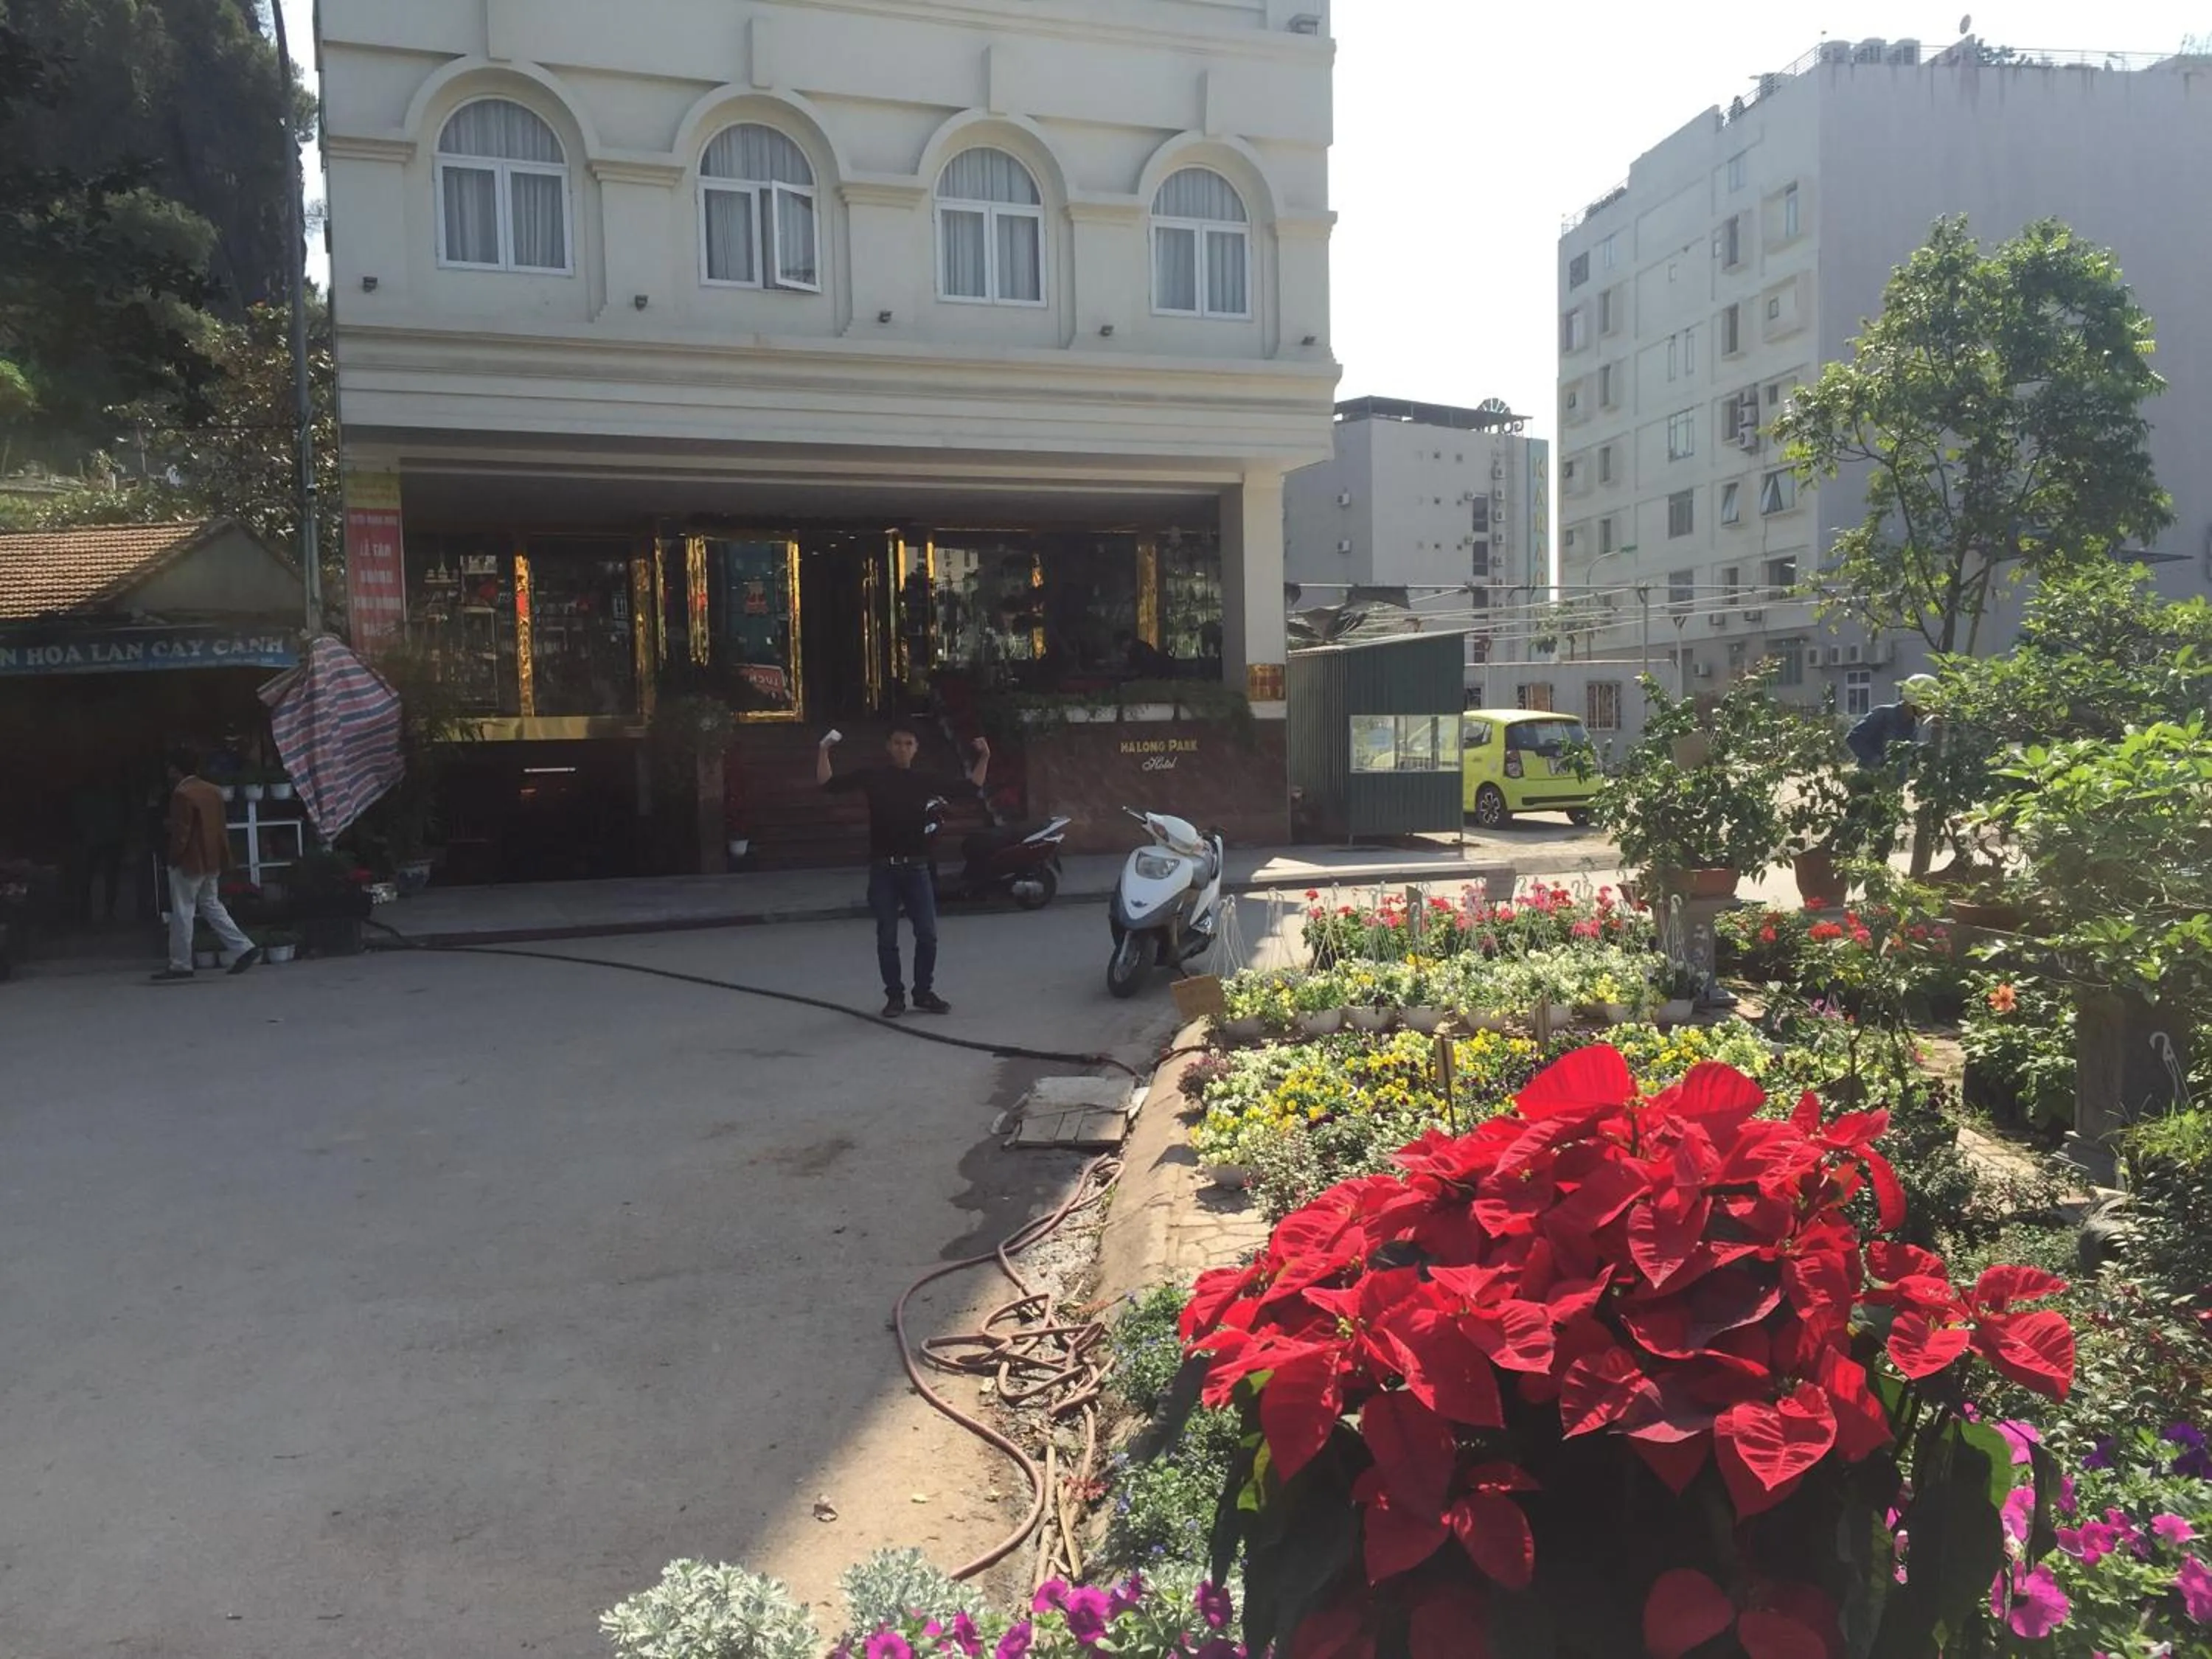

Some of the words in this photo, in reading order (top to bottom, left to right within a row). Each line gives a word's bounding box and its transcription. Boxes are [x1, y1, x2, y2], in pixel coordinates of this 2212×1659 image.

[26, 644, 83, 666] HOA
[88, 641, 144, 662] LAN
[1168, 739, 1198, 751] PARK
